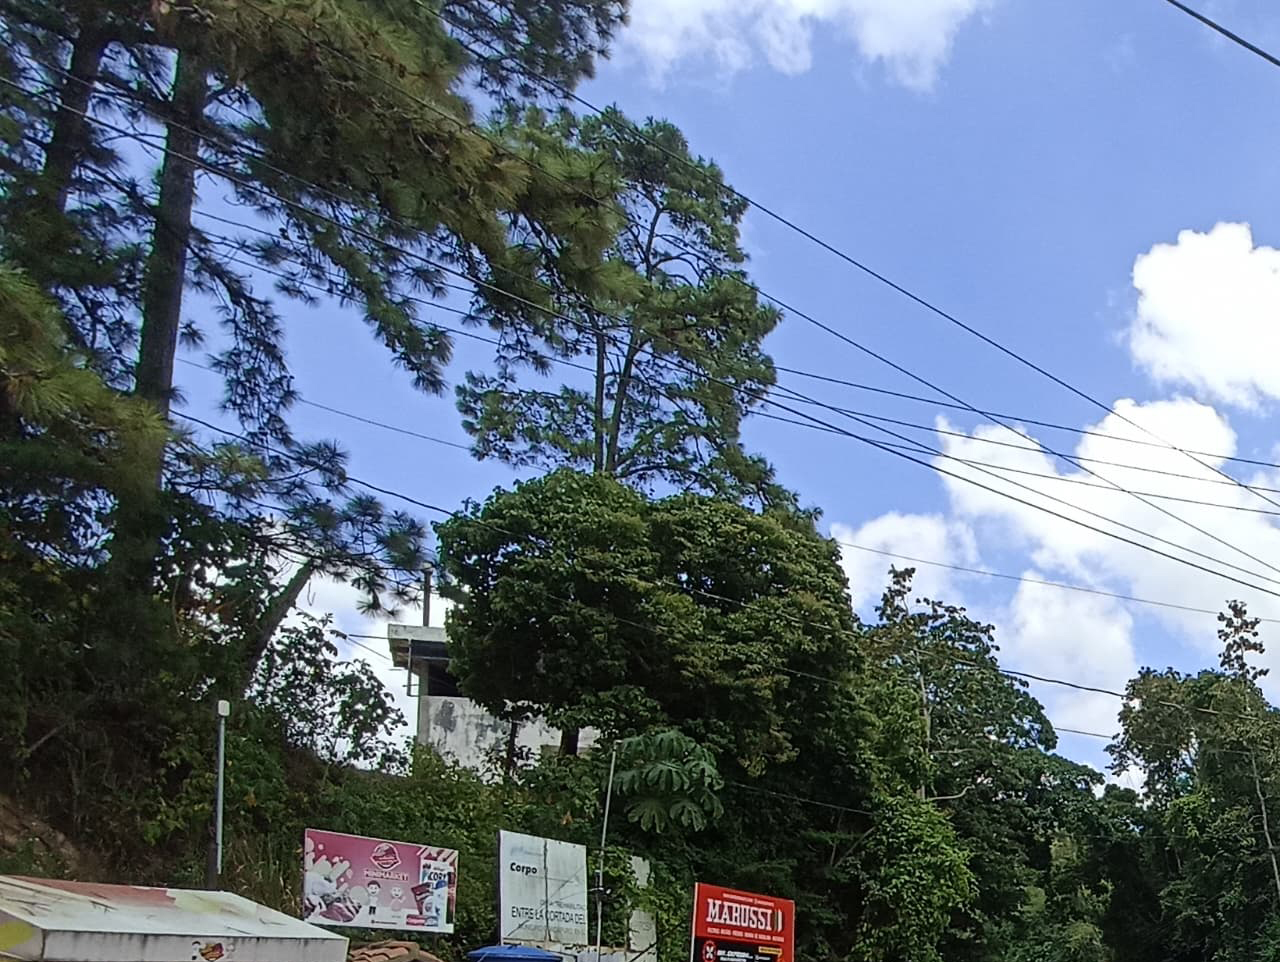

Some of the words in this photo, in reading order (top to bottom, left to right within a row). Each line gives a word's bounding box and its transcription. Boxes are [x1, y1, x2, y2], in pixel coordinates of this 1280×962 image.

[510, 862, 538, 876] Corpo
[511, 905, 534, 920] ENTRE
[546, 910, 574, 923] ORTADA
[706, 898, 772, 931] MARUSSI
